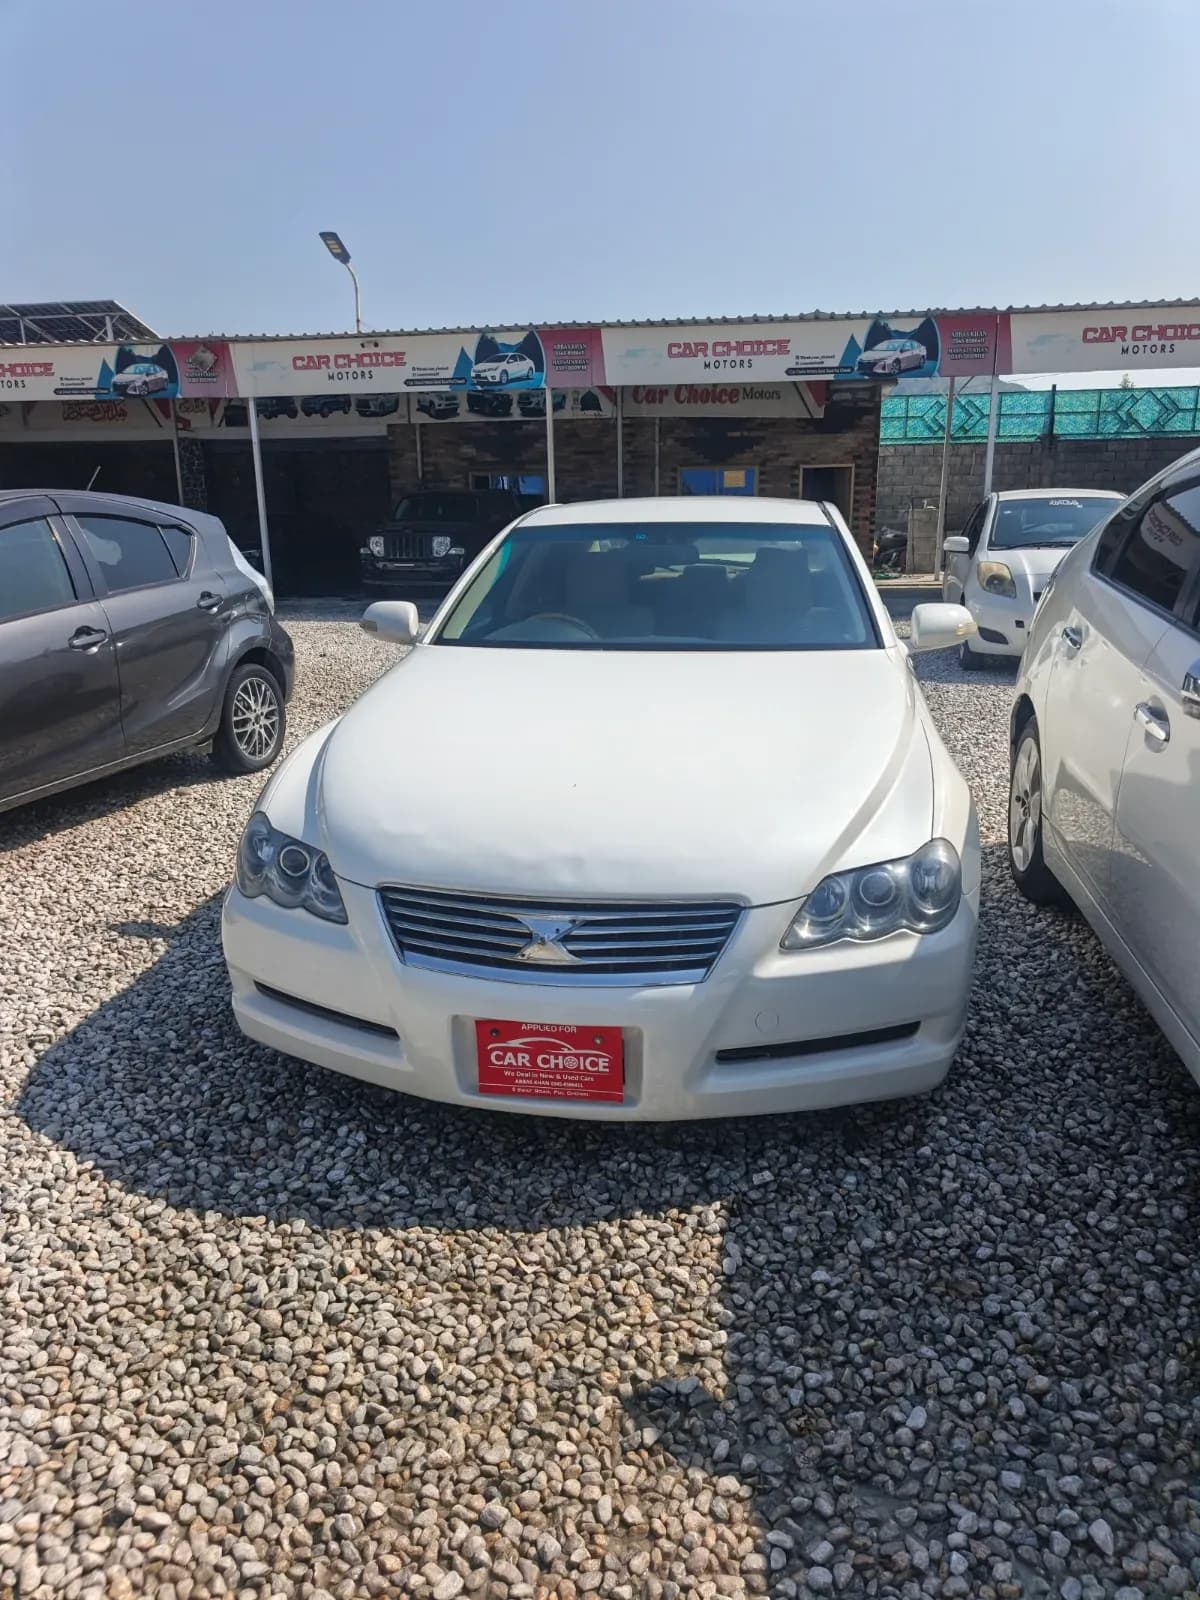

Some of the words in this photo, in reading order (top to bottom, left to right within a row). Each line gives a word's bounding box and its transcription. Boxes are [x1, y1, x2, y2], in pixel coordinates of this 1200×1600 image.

[1082, 326, 1128, 343] CAR
[1131, 323, 1200, 342] CHOIC
[667, 342, 709, 359] CAR
[712, 339, 791, 357] CHOICE
[1121, 344, 1175, 355] MOTORS
[292, 355, 331, 371] CAR
[334, 352, 407, 369] CHOICE
[704, 359, 753, 370] MOTORS
[0, 362, 55, 377] HOICE
[328, 370, 374, 381] MOTORS
[0, 379, 26, 389] TORS
[632, 384, 669, 404] Car
[674, 384, 739, 404] Choice
[742, 386, 781, 400] Motors
[521, 1023, 558, 1032] APPLIED
[559, 1025, 577, 1033] FOR
[491, 1051, 532, 1067] CAR
[536, 1054, 610, 1072] CHOICE
[563, 1073, 579, 1081] Used
